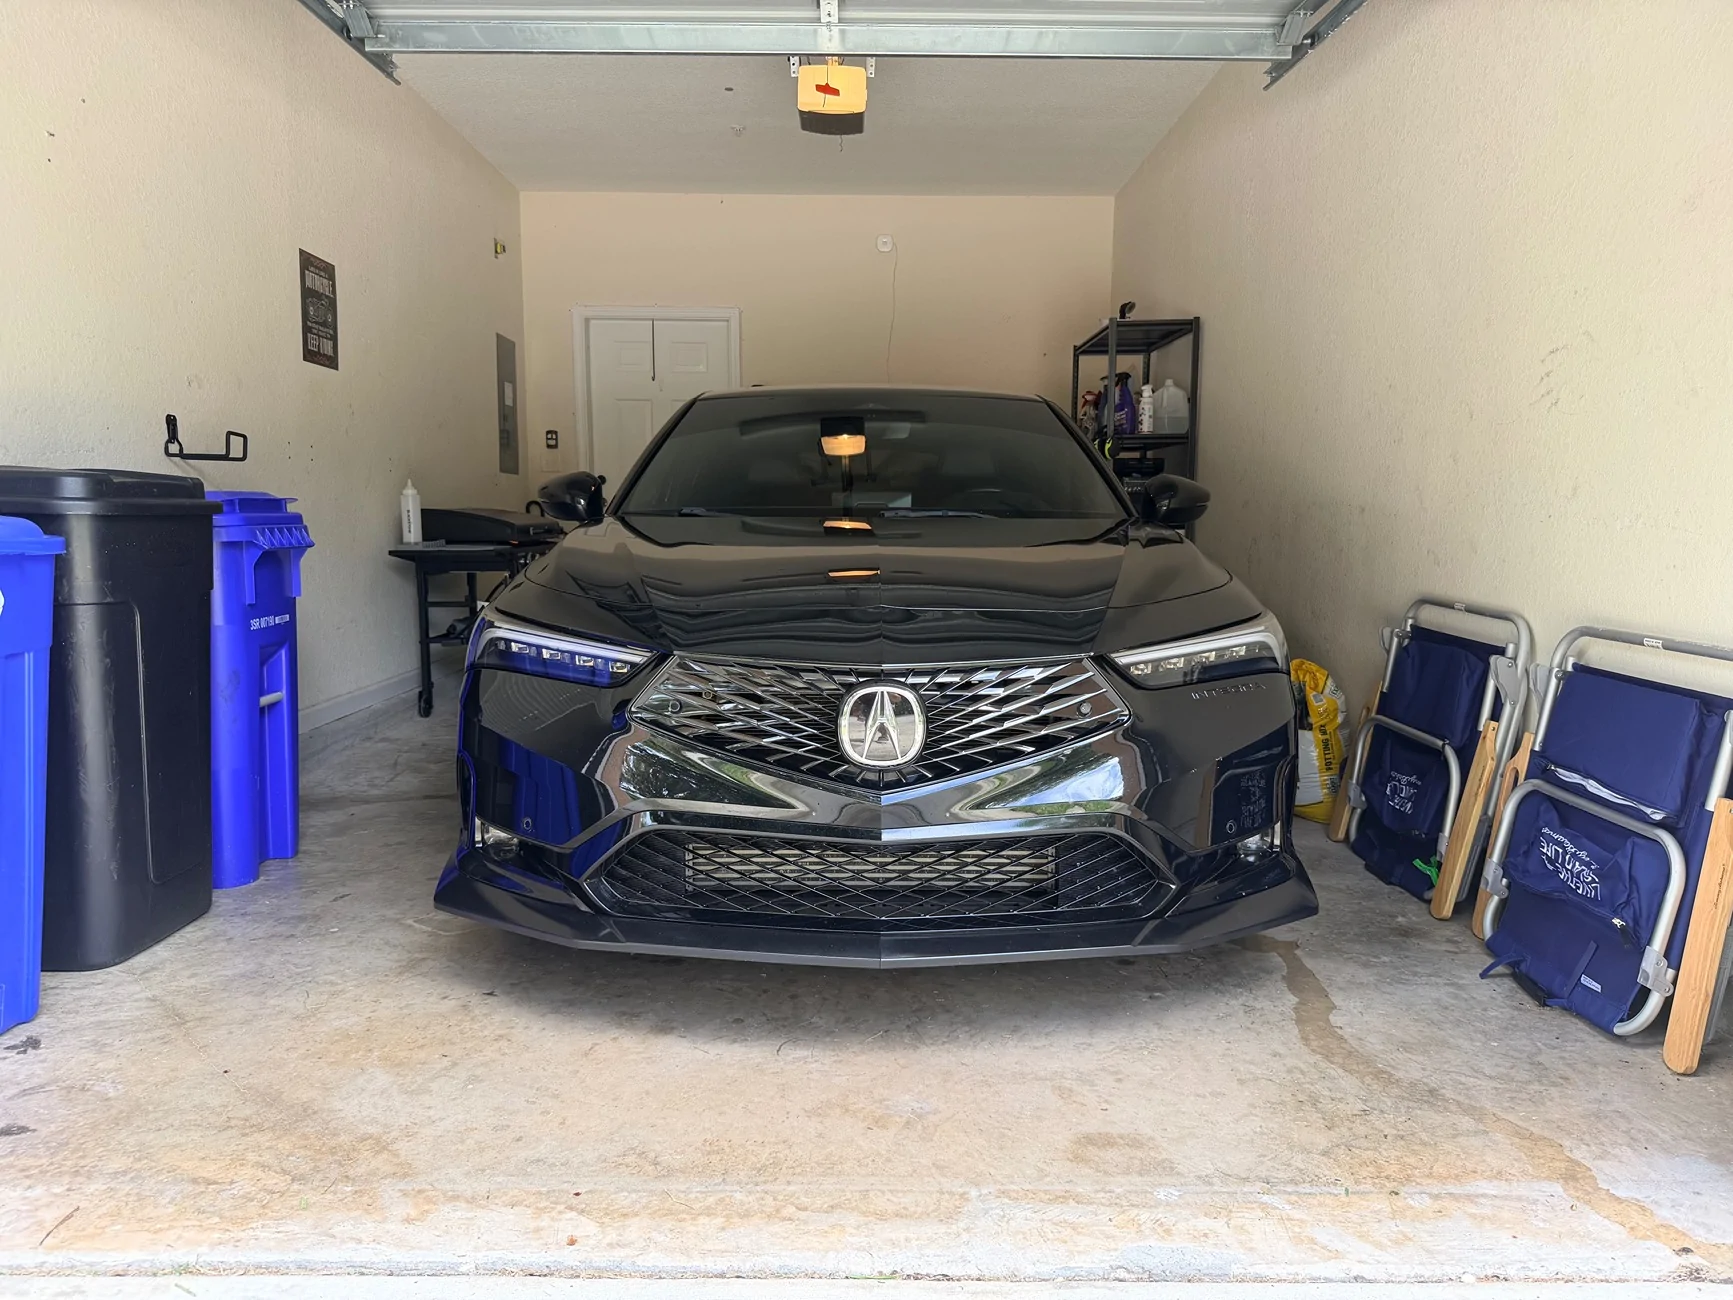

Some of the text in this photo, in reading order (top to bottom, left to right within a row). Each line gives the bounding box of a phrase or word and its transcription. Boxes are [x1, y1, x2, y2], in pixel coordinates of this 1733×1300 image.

[307, 332, 319, 352] KEEP
[250, 618, 260, 630] 3SR
[1191, 681, 1267, 700] INTEGRA
[1321, 738, 1334, 771] POTTING
[1540, 836, 1563, 864] LIFE
